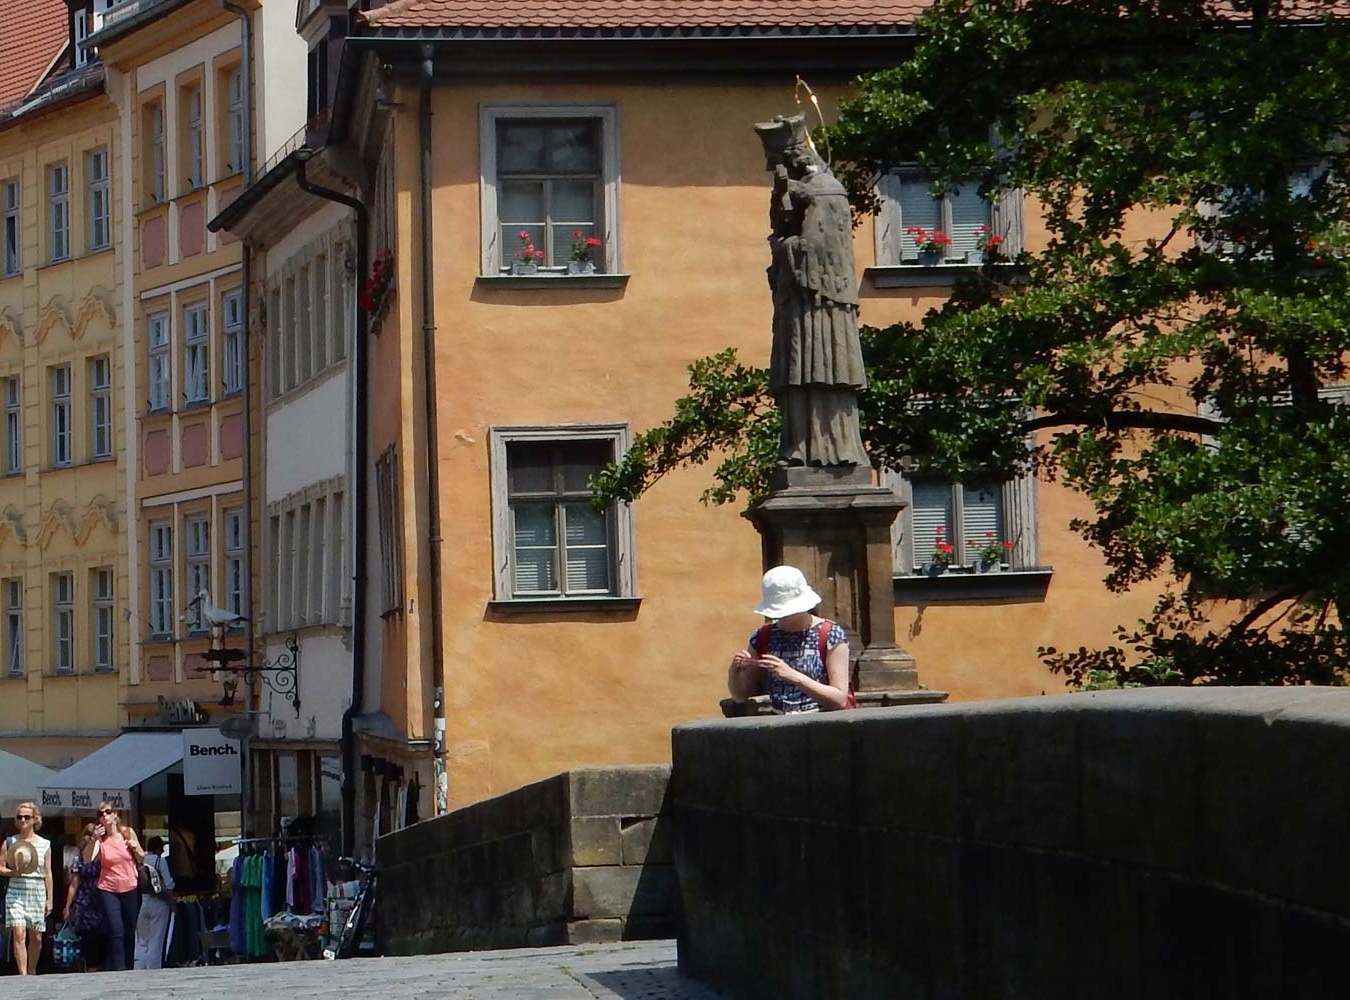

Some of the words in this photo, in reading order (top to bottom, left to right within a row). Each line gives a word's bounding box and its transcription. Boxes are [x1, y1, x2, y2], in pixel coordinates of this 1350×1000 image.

[189, 743, 238, 756] Bench.
[42, 789, 62, 806] Bench.
[71, 790, 92, 807] Bench.
